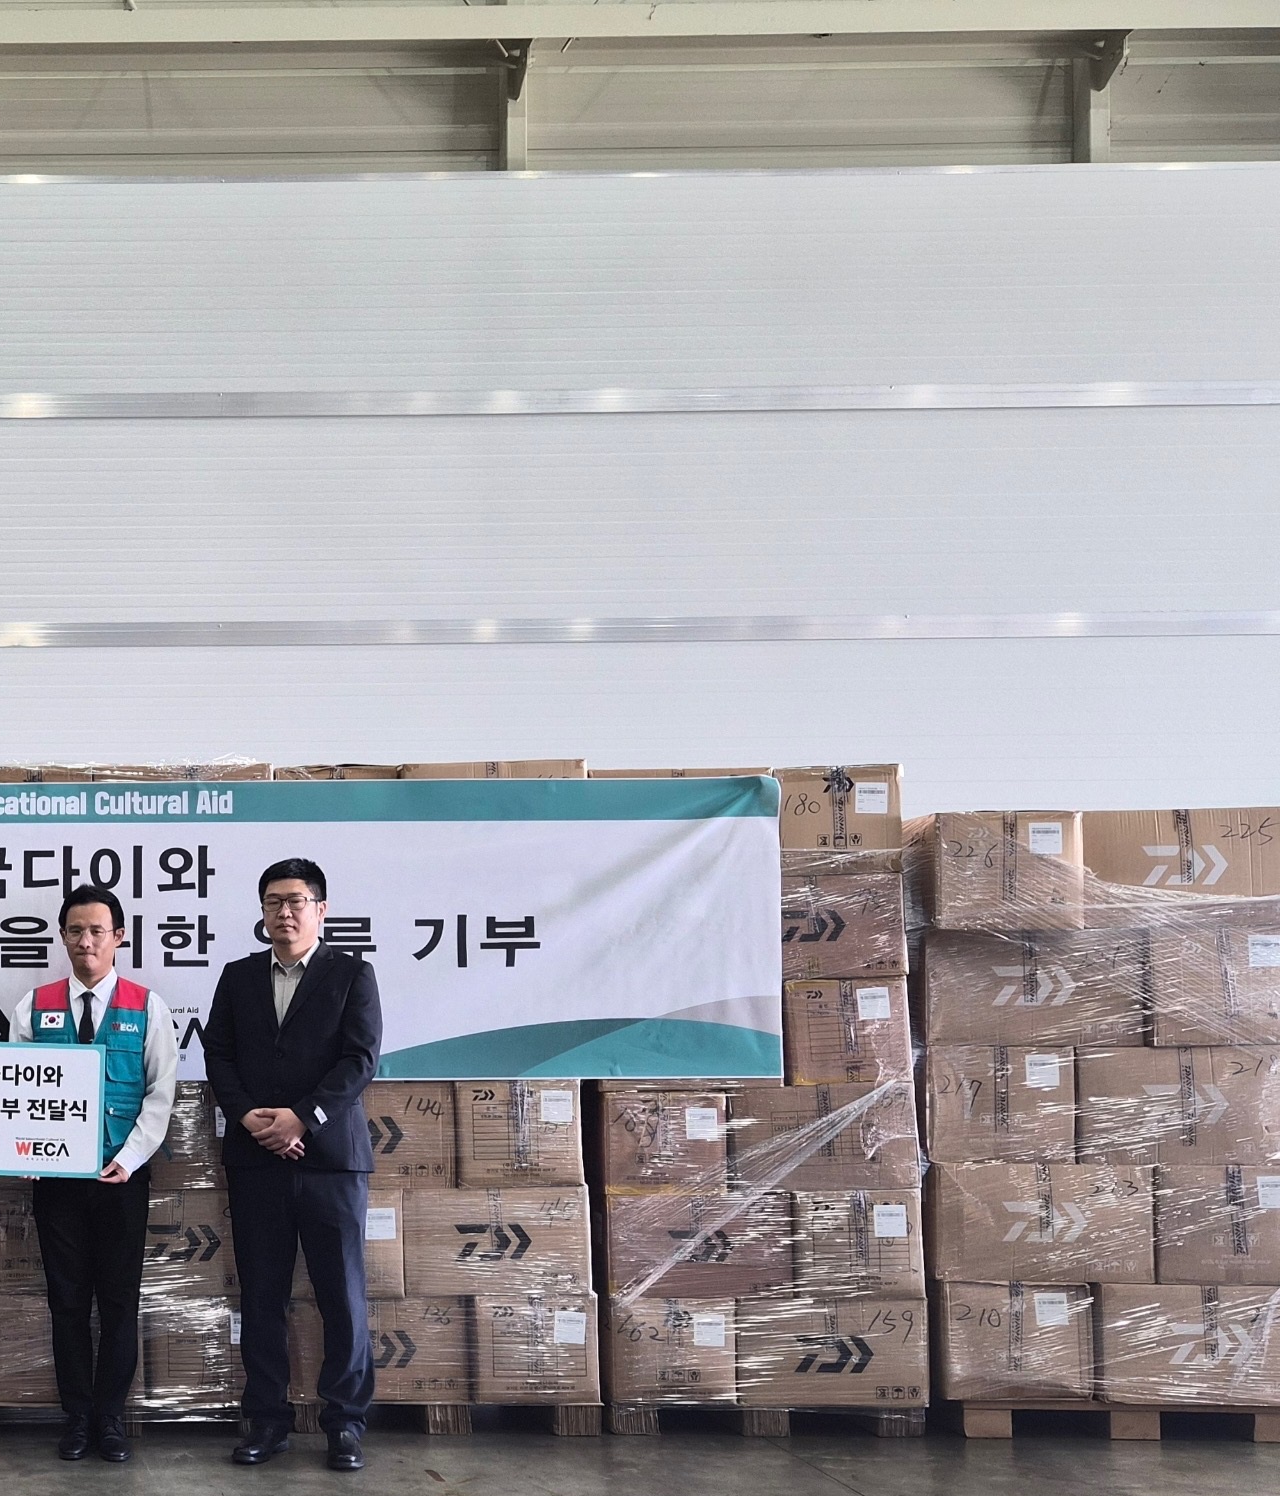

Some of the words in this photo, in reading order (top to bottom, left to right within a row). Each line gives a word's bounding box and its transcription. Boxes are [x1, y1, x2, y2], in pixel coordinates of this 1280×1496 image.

[94, 790, 189, 816] Cultural
[196, 790, 234, 815] Aid
[783, 792, 822, 816] 180
[1219, 816, 1280, 846] 225
[949, 840, 999, 868] 226
[411, 913, 542, 969] 기부
[187, 1006, 199, 1014] Aid
[26, 1098, 88, 1122] 전달식
[403, 1094, 445, 1121] 144
[15, 1141, 70, 1157] WECA
[868, 1309, 914, 1344] 159
[955, 1304, 1002, 1328] 210
